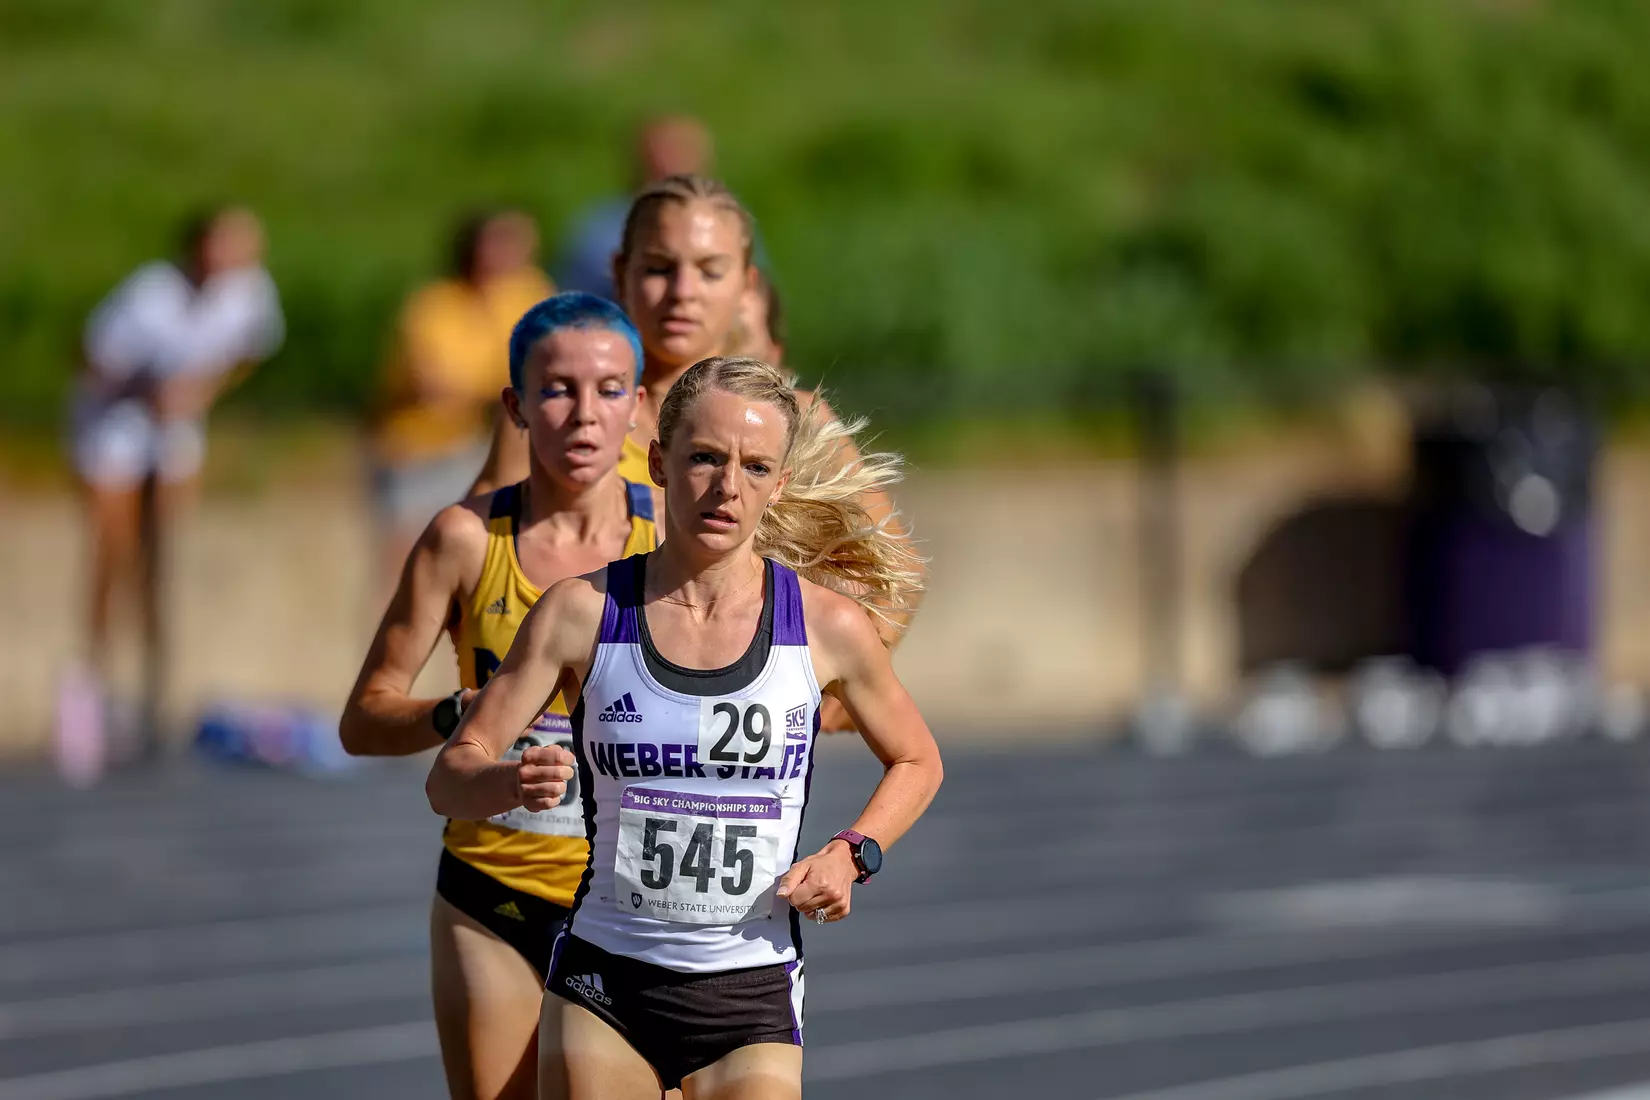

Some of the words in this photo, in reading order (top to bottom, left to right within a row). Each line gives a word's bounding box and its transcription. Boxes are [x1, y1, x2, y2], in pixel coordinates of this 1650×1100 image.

[599, 711, 643, 723] adidas
[786, 708, 806, 728] SKY
[709, 702, 772, 764] 29
[590, 741, 706, 778] WEBER
[634, 795, 651, 804] BIG
[652, 797, 670, 807] SKY
[672, 799, 748, 813] CHAMPIONSHIPS
[749, 804, 770, 813] 2021
[640, 817, 758, 896] 545
[648, 899, 679, 910] WEBER
[680, 903, 707, 912] STATE
[709, 904, 757, 914] UNIVERSITY
[565, 976, 612, 1006] adidas
